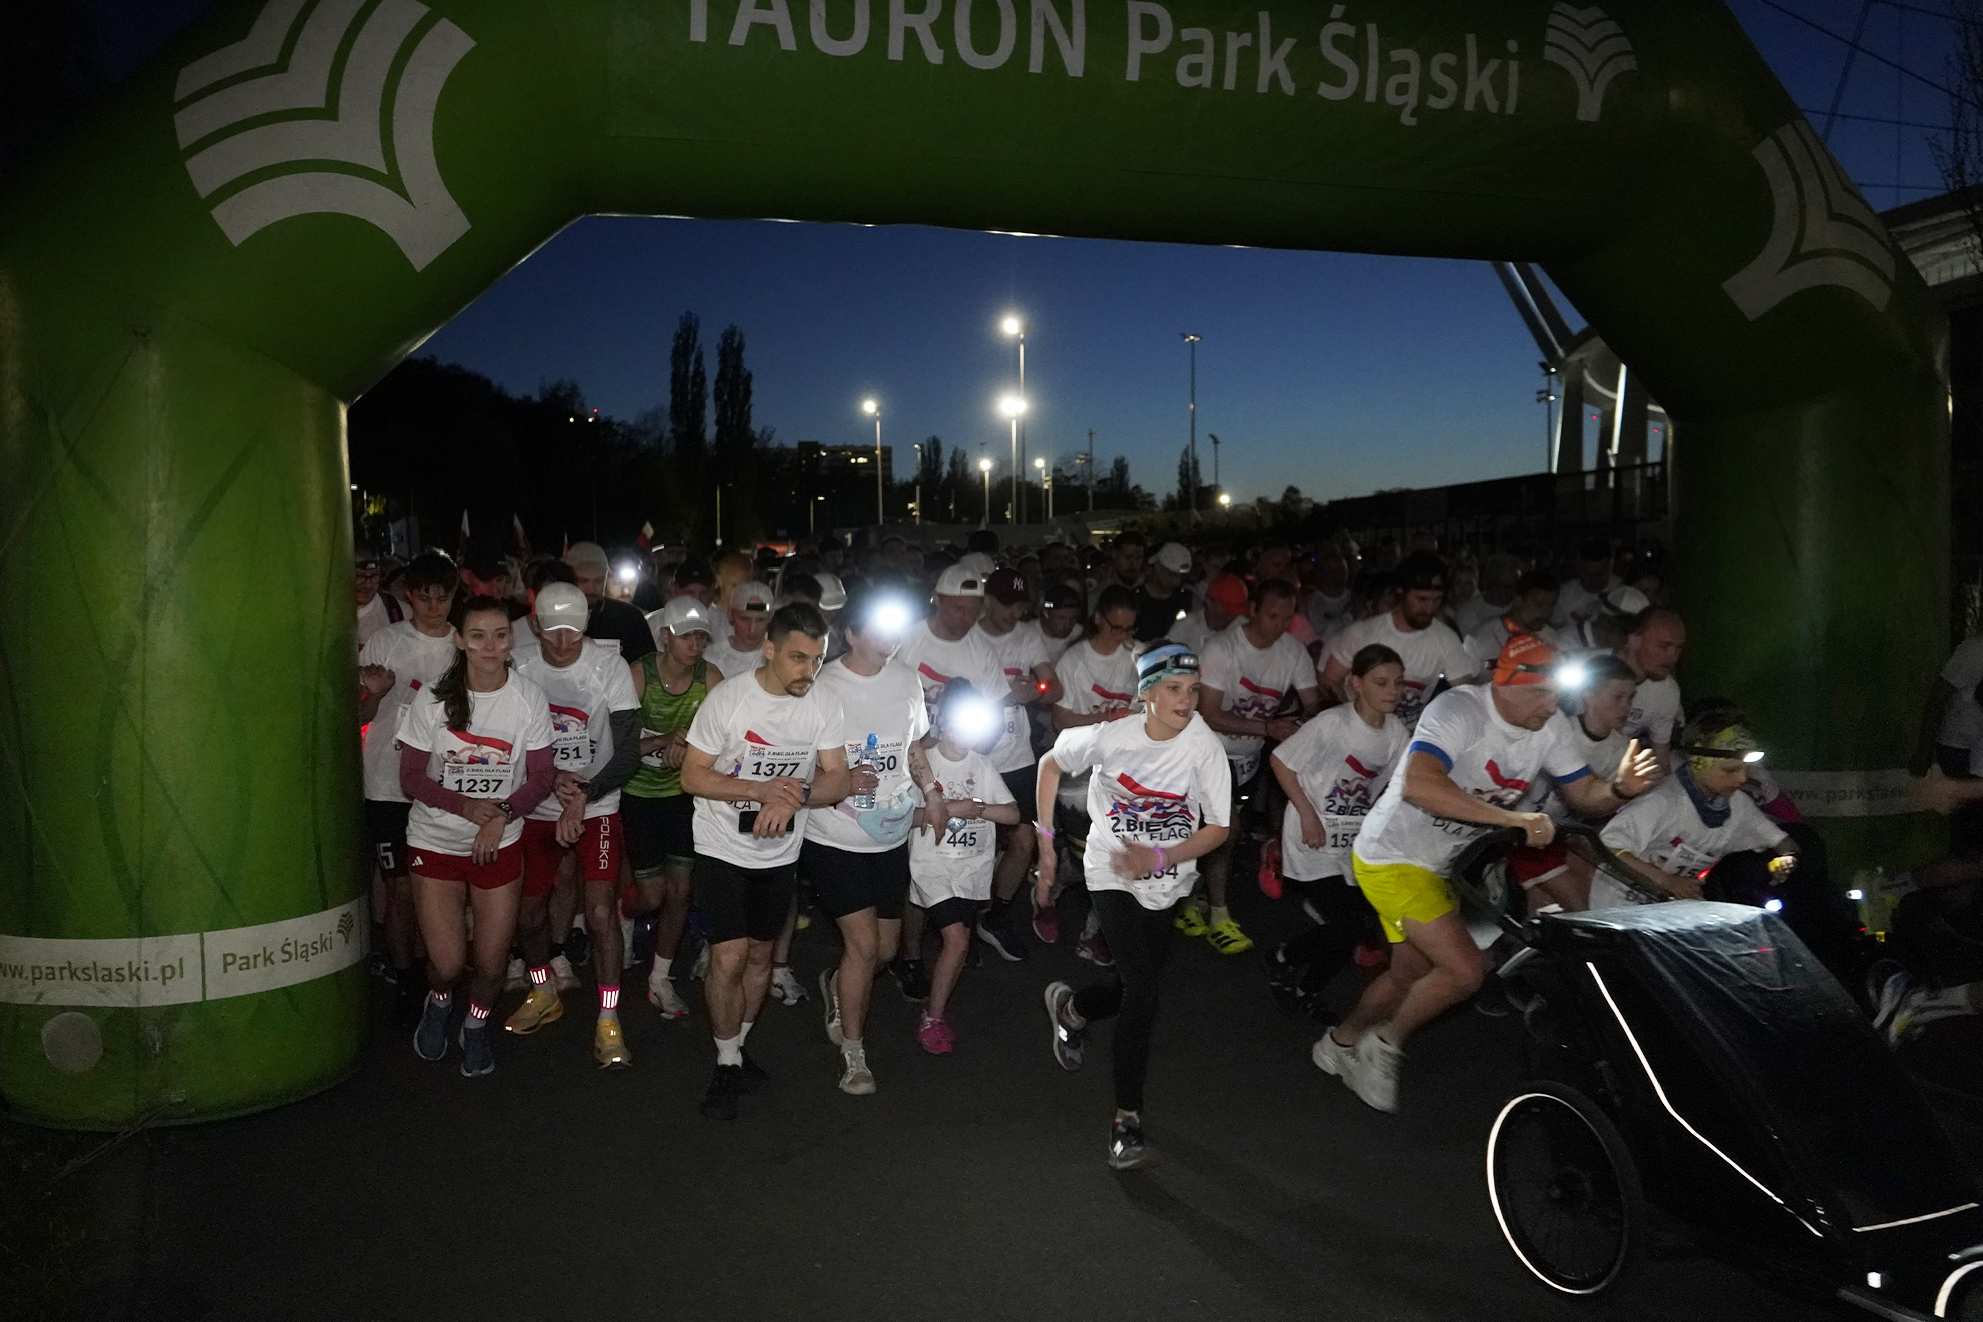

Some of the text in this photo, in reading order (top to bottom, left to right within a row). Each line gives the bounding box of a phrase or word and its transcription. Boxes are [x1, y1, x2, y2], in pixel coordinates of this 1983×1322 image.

[1124, 0, 1297, 96] Park
[1317, 4, 1520, 126] Śląski
[751, 761, 800, 777] 1377
[454, 778, 504, 793] 1237
[725, 799, 752, 810] LA
[598, 816, 610, 870] POLSKA
[946, 832, 977, 847] 445
[222, 931, 333, 974] Park Śląski
